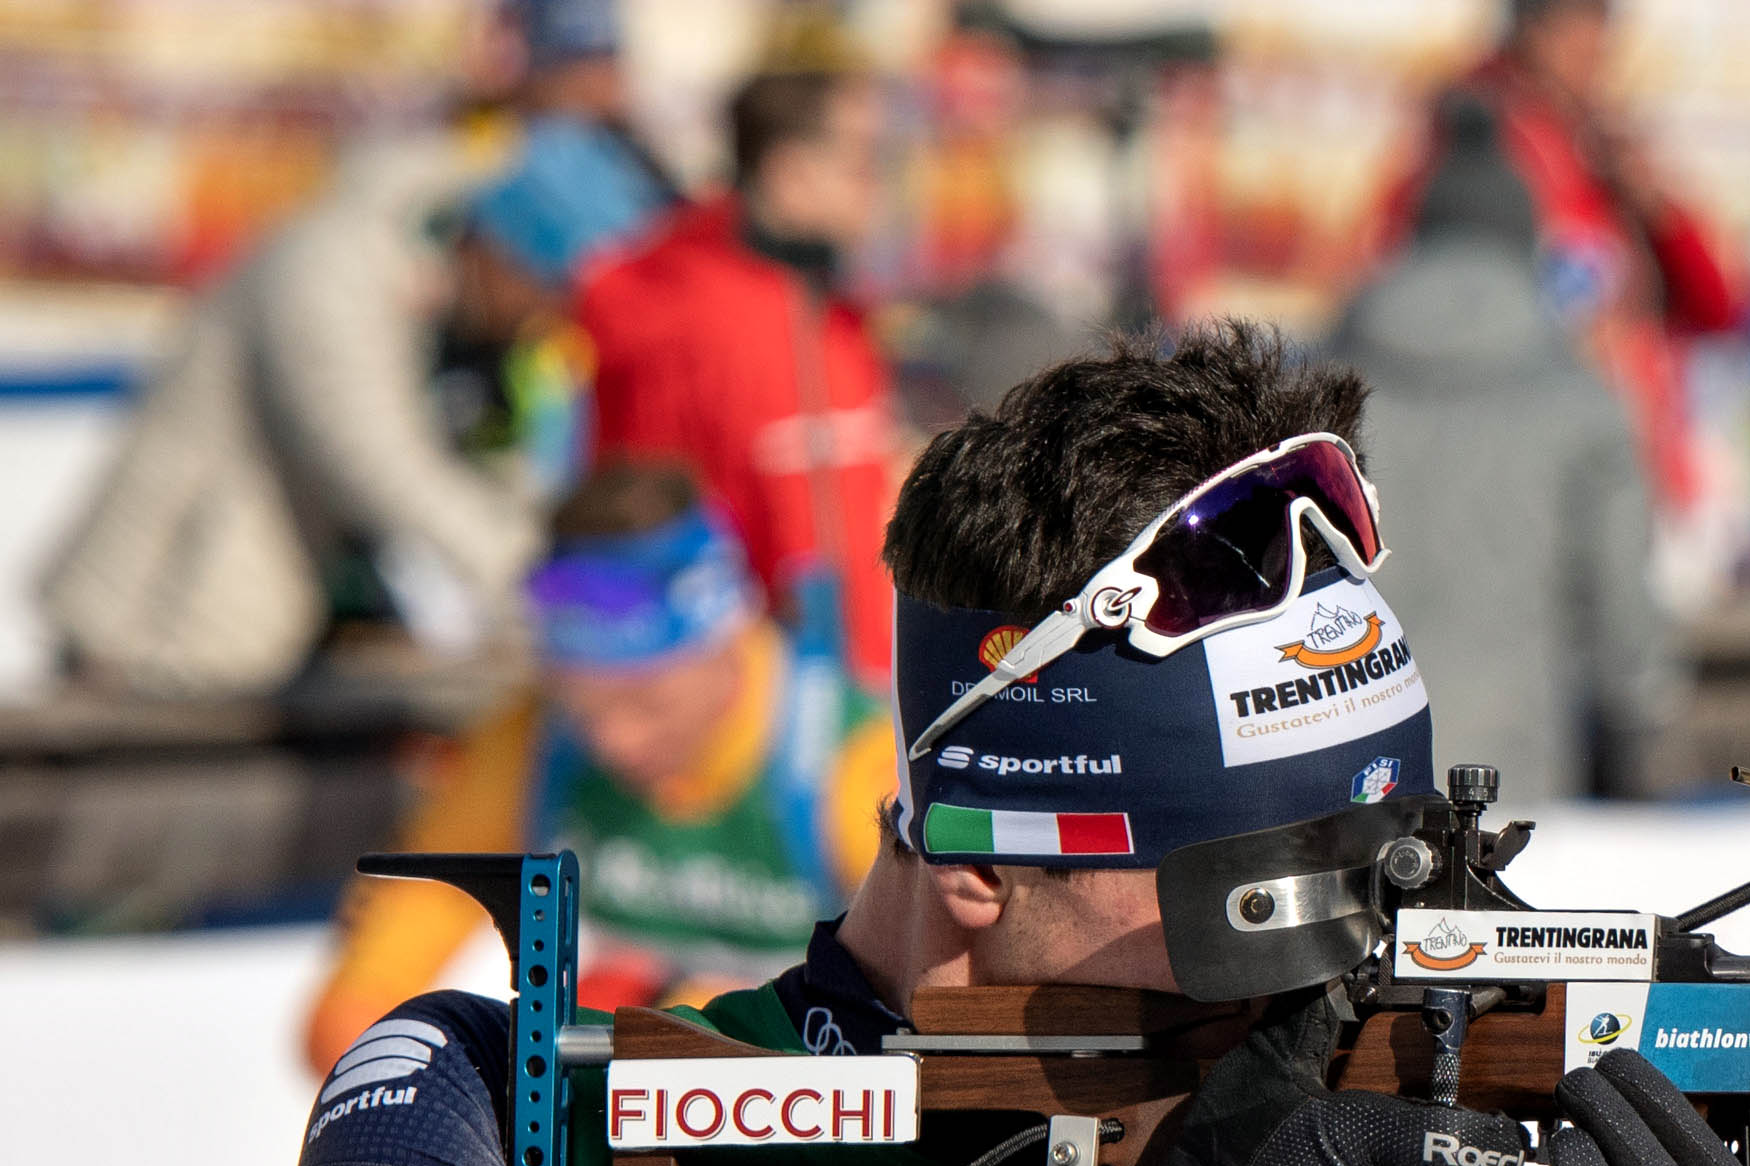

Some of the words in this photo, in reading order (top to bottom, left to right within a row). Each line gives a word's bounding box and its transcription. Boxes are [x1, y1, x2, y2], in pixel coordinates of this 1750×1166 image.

[1229, 634, 1412, 718] TRENTINGRAN
[1050, 687, 1098, 703] SRL
[977, 753, 1123, 777] sportful
[1495, 926, 1649, 949] TRENTINGRANA
[1493, 951, 1552, 966] Gustatevi
[1553, 952, 1560, 965] il
[1565, 954, 1603, 966] nostro
[1606, 953, 1648, 966] mondo
[307, 1085, 418, 1144] sportful
[610, 1087, 896, 1141] FIOCCHI
